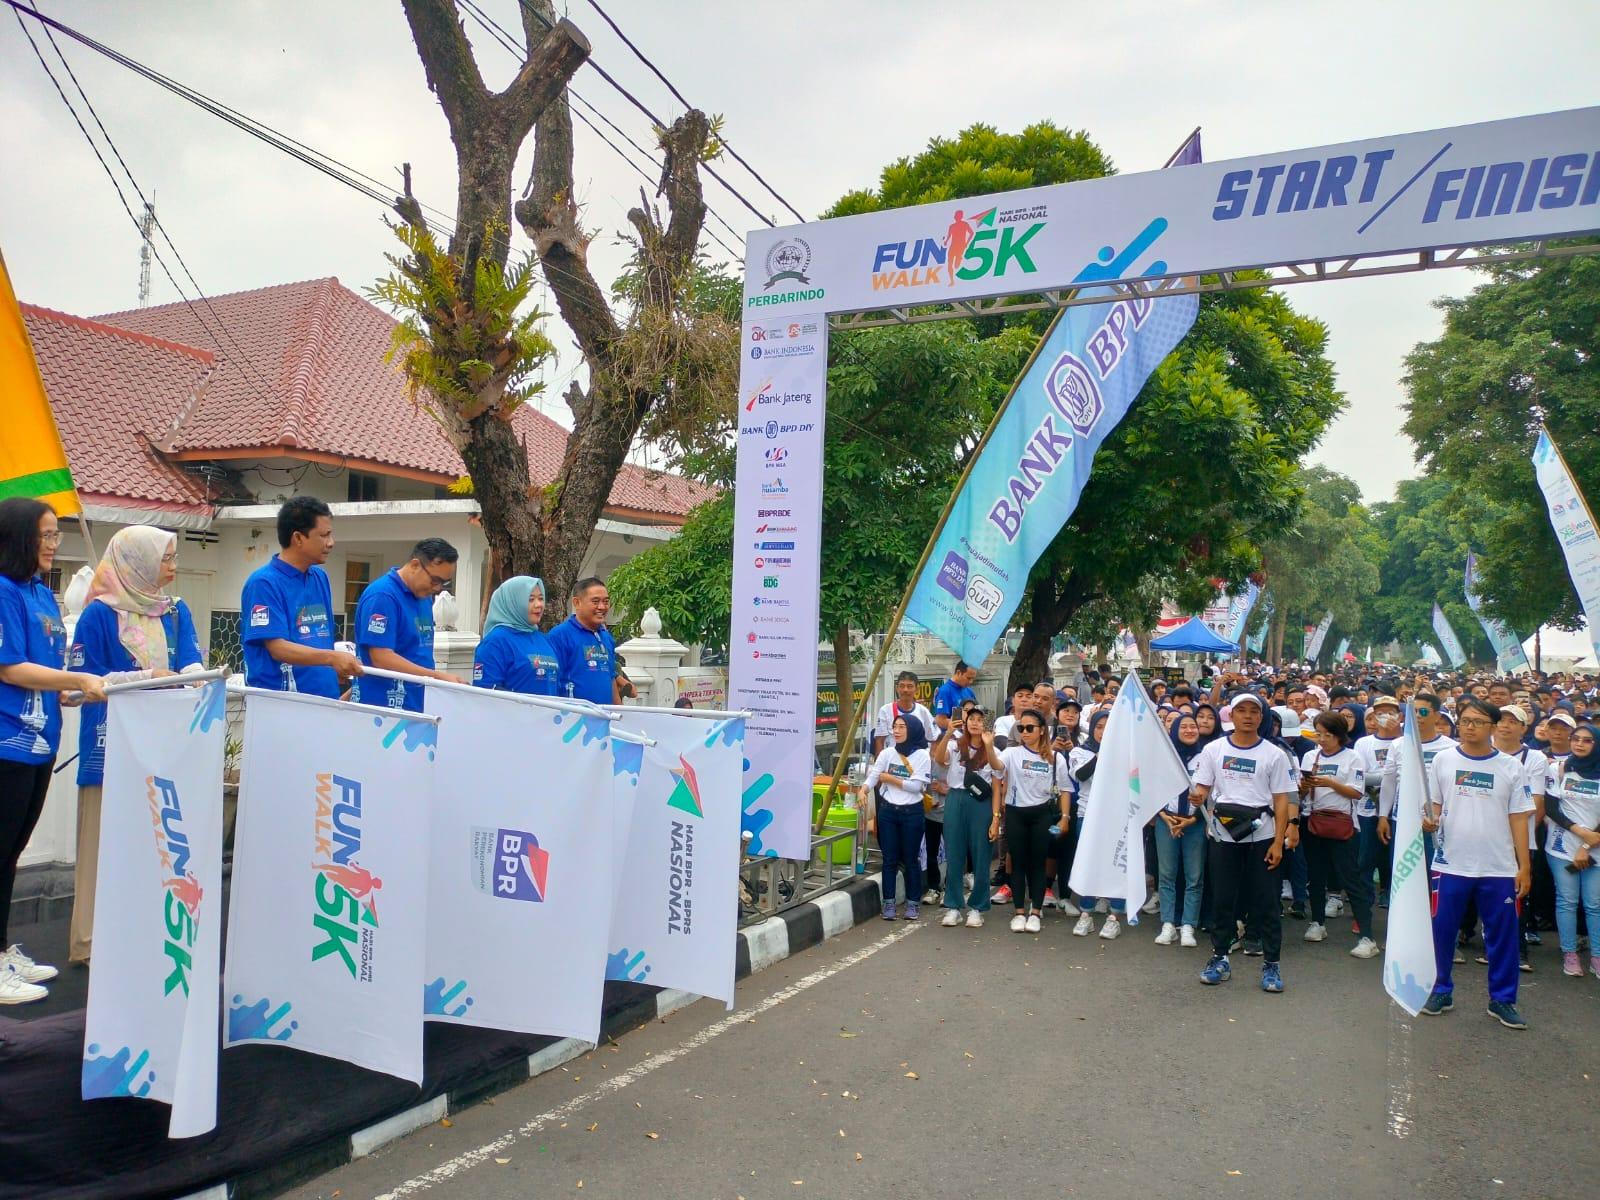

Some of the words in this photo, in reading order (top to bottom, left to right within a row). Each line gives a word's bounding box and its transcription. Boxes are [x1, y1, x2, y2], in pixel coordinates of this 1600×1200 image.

[1212, 149, 1395, 221] START
[999, 211, 1048, 223] NASIONAL
[871, 266, 942, 291] WALK
[872, 238, 946, 272] FUN
[956, 222, 1047, 281] 5K
[748, 288, 825, 308] PERBARINDO
[758, 393, 781, 405] Bank
[782, 392, 812, 405] Jateng
[742, 427, 764, 435] BANK
[780, 425, 798, 433] BPD
[799, 424, 815, 432] DIY
[989, 415, 1073, 543] BANK
[145, 775, 172, 871] WALK
[153, 775, 191, 877] FUN
[314, 772, 332, 860] WALK
[332, 774, 361, 867] FUN
[685, 824, 693, 857] HARI
[498, 835, 522, 894] BPR
[668, 820, 684, 935] NASIONAL
[684, 860, 693, 888] BPR
[164, 888, 193, 1000] 5K
[311, 872, 359, 981] 5K
[683, 899, 692, 935] BPRS
[360, 927, 369, 982] NASIONAL
